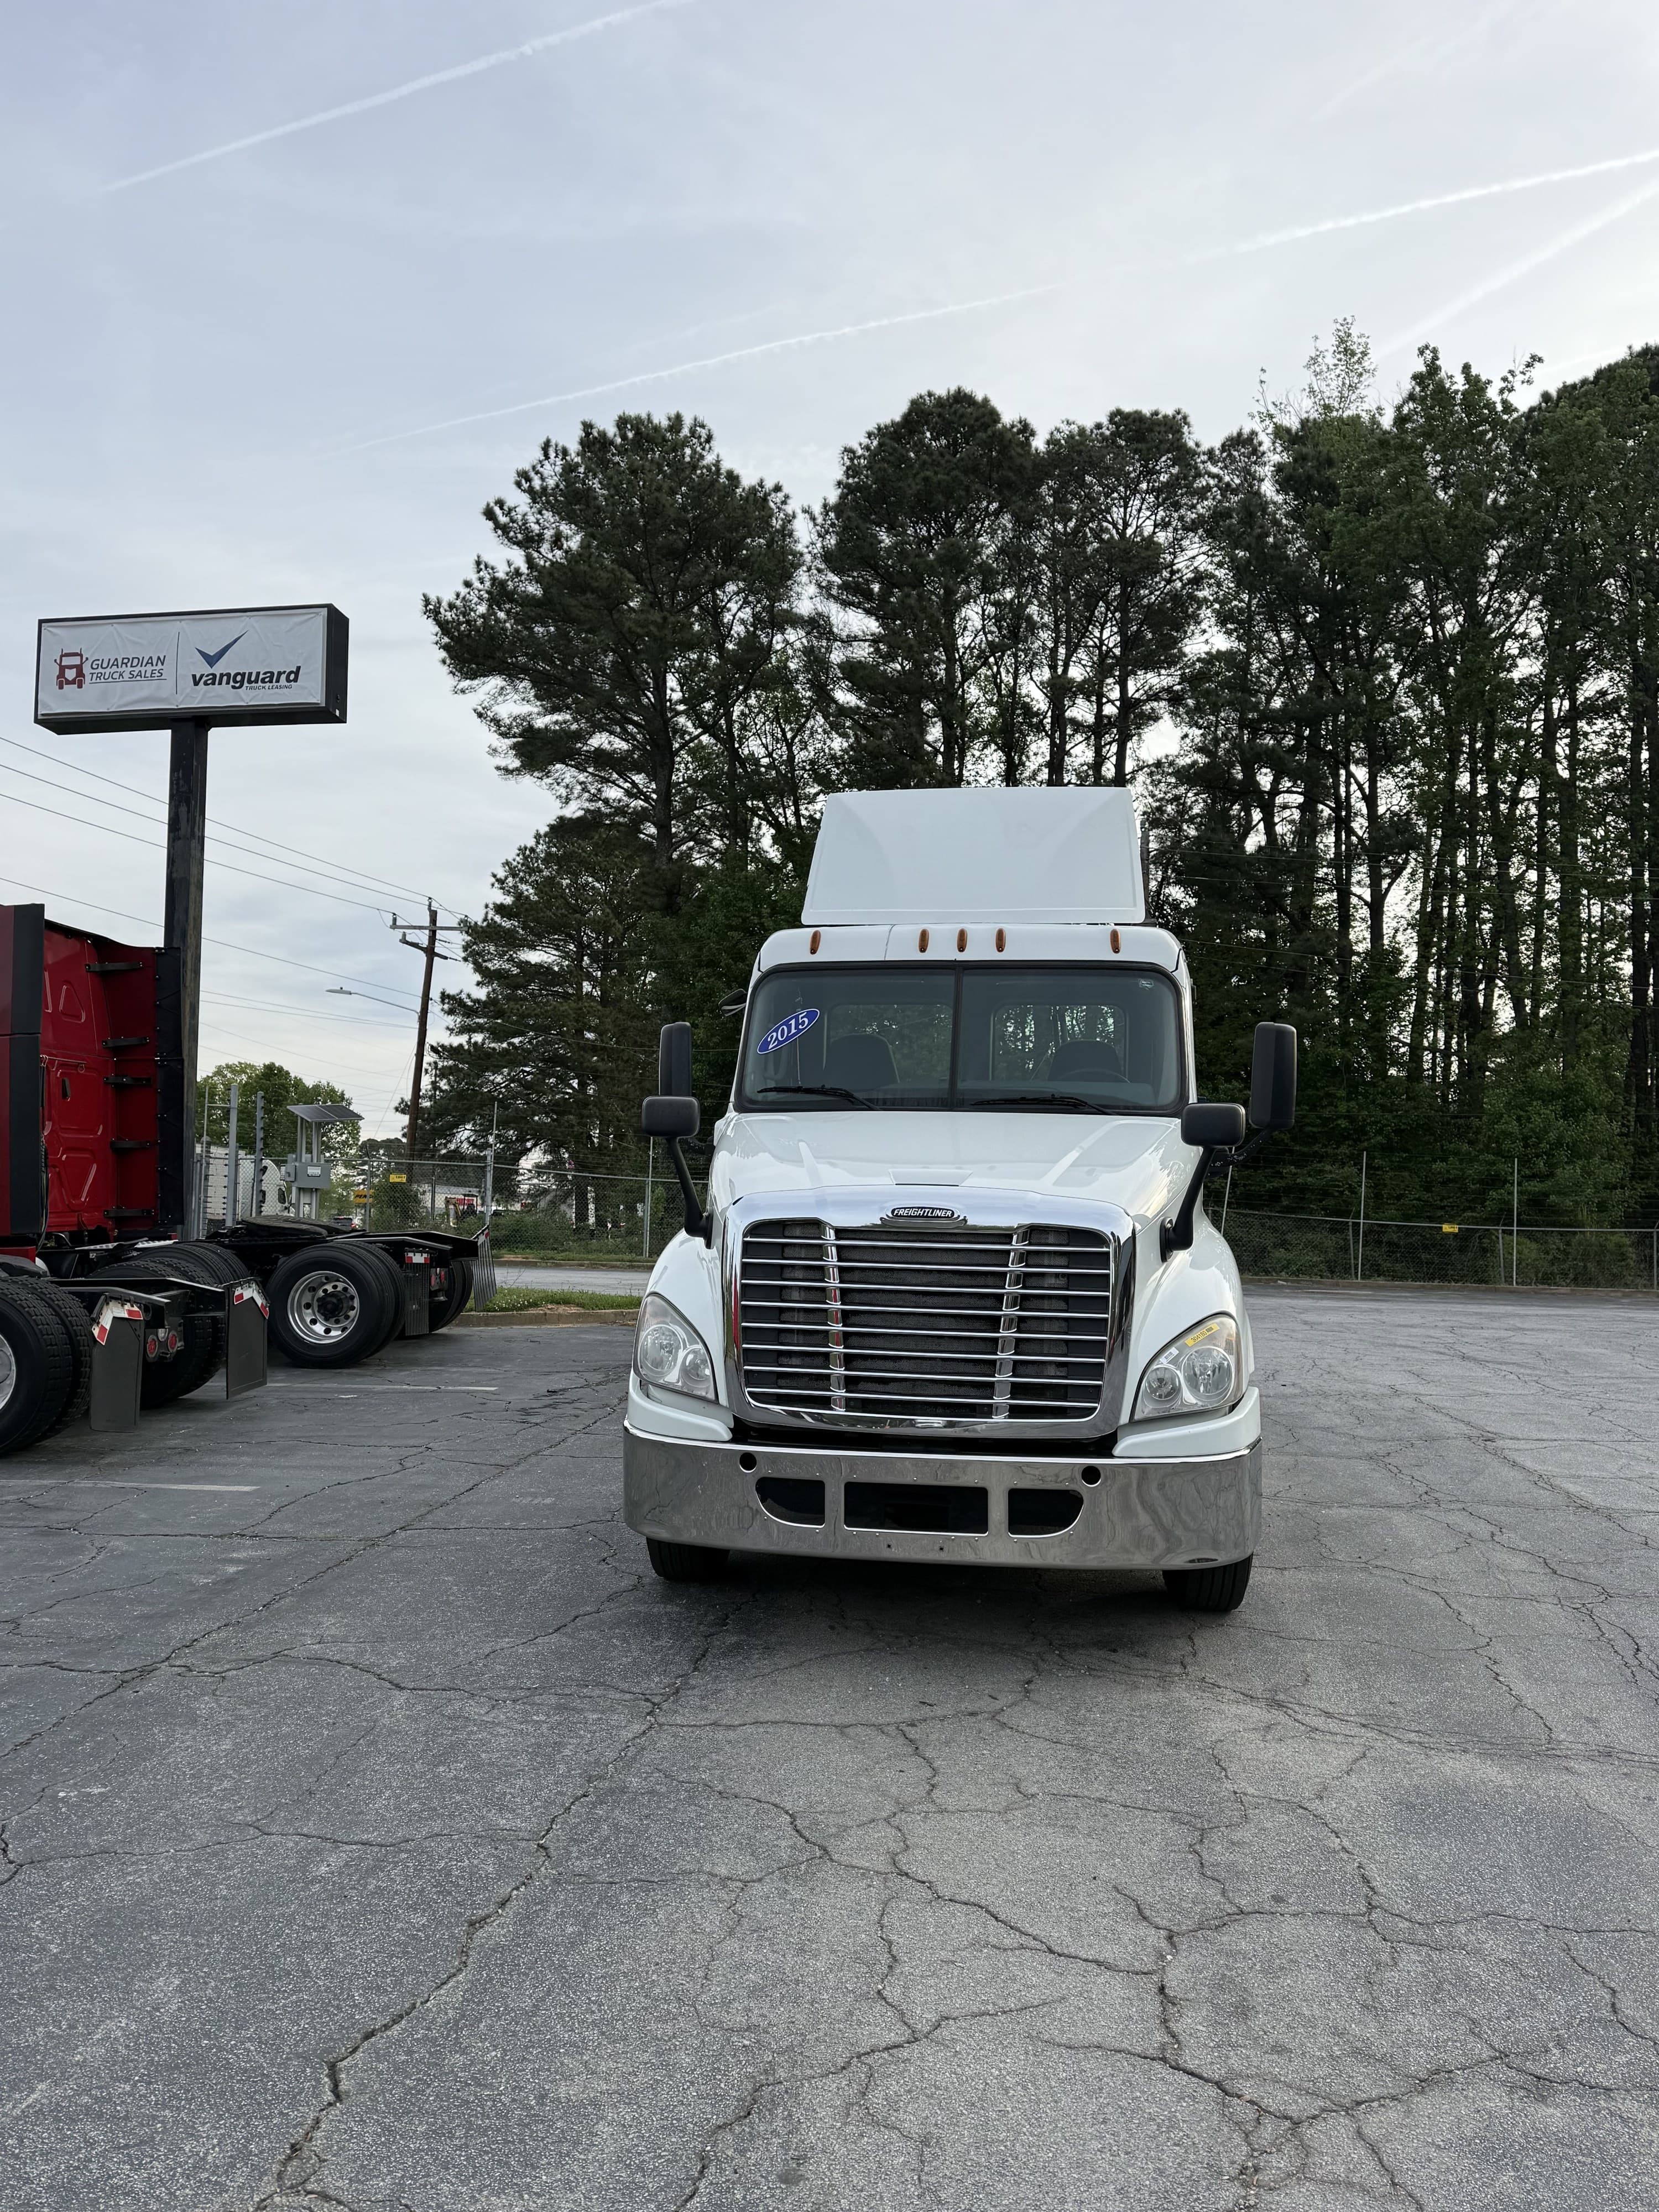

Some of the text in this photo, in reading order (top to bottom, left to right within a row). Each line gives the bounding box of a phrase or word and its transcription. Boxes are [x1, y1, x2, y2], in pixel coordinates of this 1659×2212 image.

[90, 655, 166, 670] GUARDIAN
[89, 669, 164, 681] TRUCK SALES
[191, 665, 301, 690] vanguard
[768, 1011, 808, 1050] 2015
[894, 1208, 952, 1217] FREIGHTLINER
